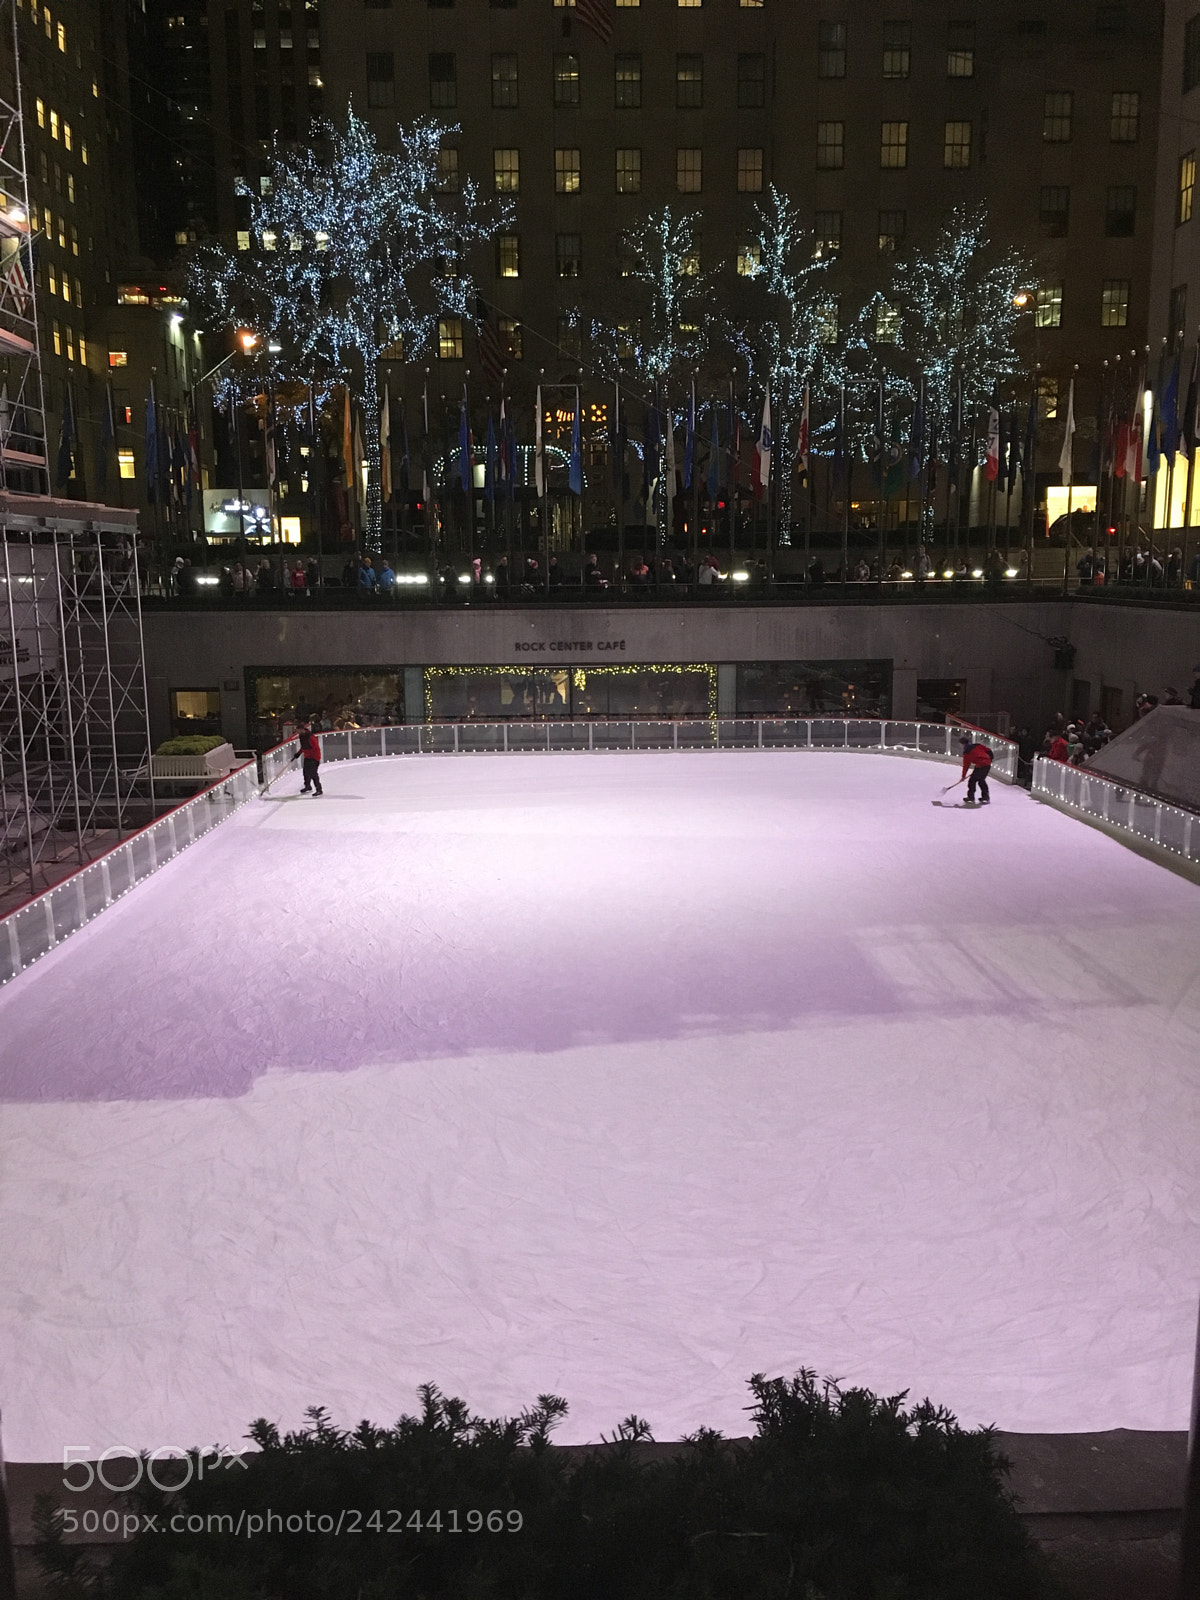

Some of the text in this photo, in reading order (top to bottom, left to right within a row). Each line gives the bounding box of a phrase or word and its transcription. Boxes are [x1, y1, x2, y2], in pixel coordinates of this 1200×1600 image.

[515, 640, 626, 652] ROCK CENTER CAFÉ
